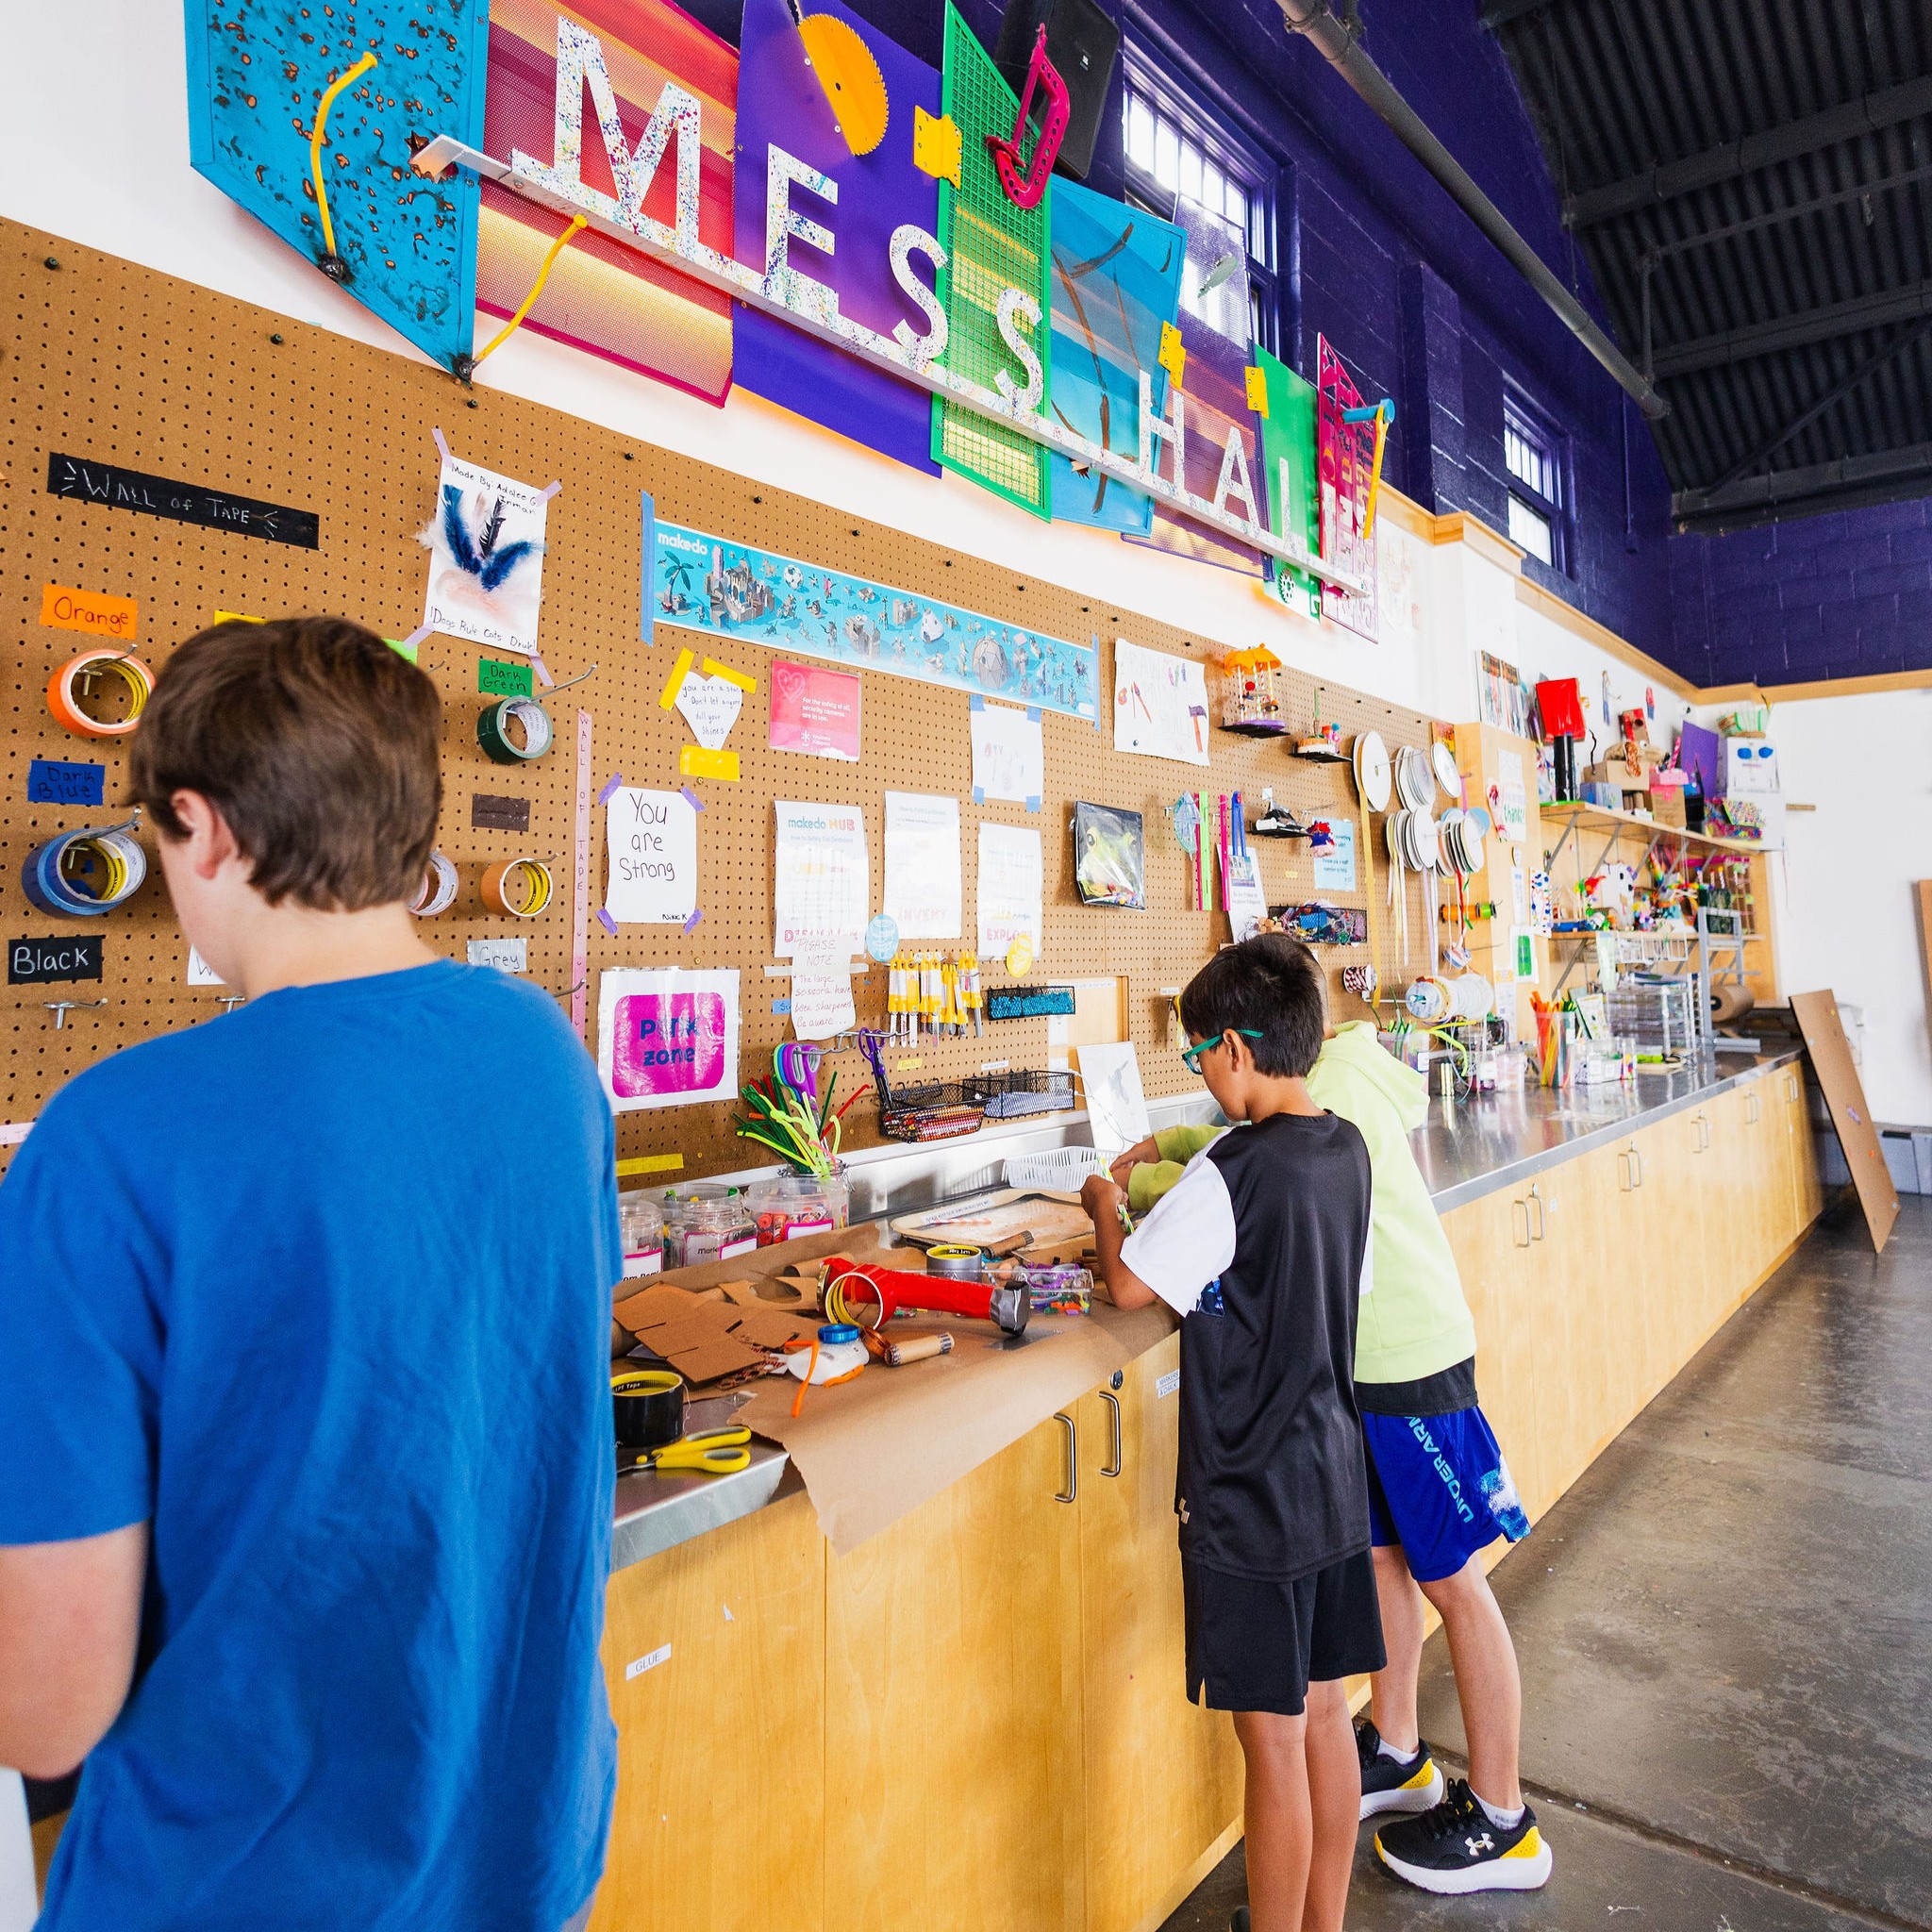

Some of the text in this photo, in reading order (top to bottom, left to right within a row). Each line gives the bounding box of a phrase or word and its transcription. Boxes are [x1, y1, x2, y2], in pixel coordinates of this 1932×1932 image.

[553, 13, 1044, 408] MESS
[451, 465, 475, 481] Made
[83, 468, 157, 508] WALL
[171, 496, 192, 511] of
[658, 533, 708, 556] makedo
[54, 596, 129, 634] Orange
[491, 664, 521, 679] Dark
[483, 676, 526, 692] Green
[681, 685, 697, 698] you
[802, 705, 824, 714] security
[822, 701, 837, 709] safety
[579, 717, 589, 766] WALL
[47, 766, 94, 783] Dark
[38, 782, 92, 799] Blue
[579, 791, 586, 813] OF
[628, 792, 668, 825] You
[788, 816, 856, 832] makedo HUB
[631, 832, 664, 854] are
[619, 857, 675, 882] Strong
[986, 927, 1032, 941] EXPLO
[13, 945, 89, 974] Black
[479, 946, 520, 969] Grey
[813, 974, 835, 987] large
[642, 1047, 695, 1067] zone
[1433, 1454, 1474, 1524] UNDER
[635, 1650, 661, 1673] GLUE
